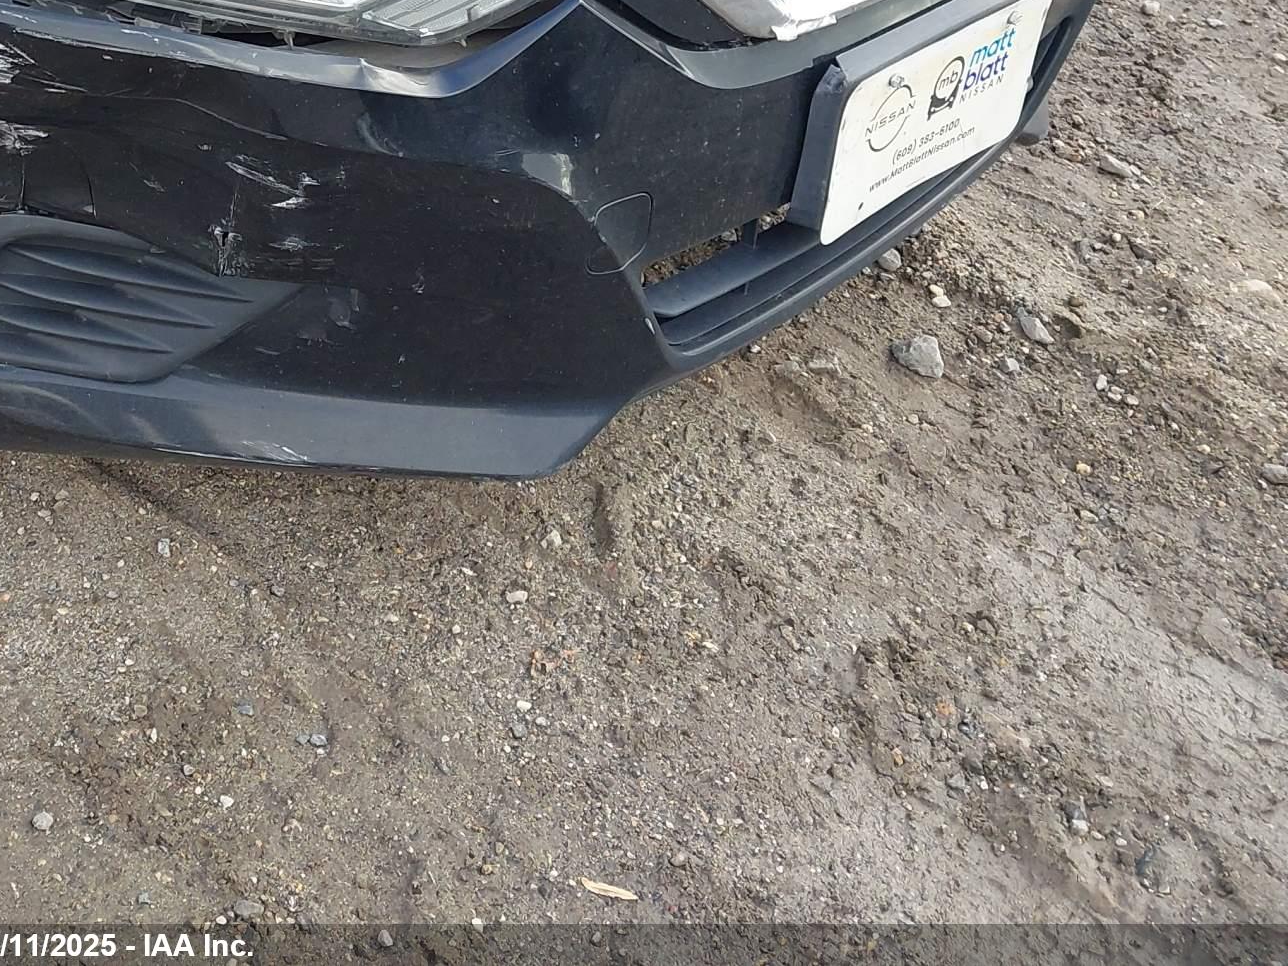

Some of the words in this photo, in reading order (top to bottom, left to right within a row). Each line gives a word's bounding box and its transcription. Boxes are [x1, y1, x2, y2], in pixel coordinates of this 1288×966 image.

[969, 27, 1016, 68] matt
[938, 70, 959, 91] mb
[963, 51, 1009, 91] blatt
[959, 74, 1004, 104] NISSAN
[864, 100, 916, 137] NISSAN
[892, 138, 917, 165] (609)
